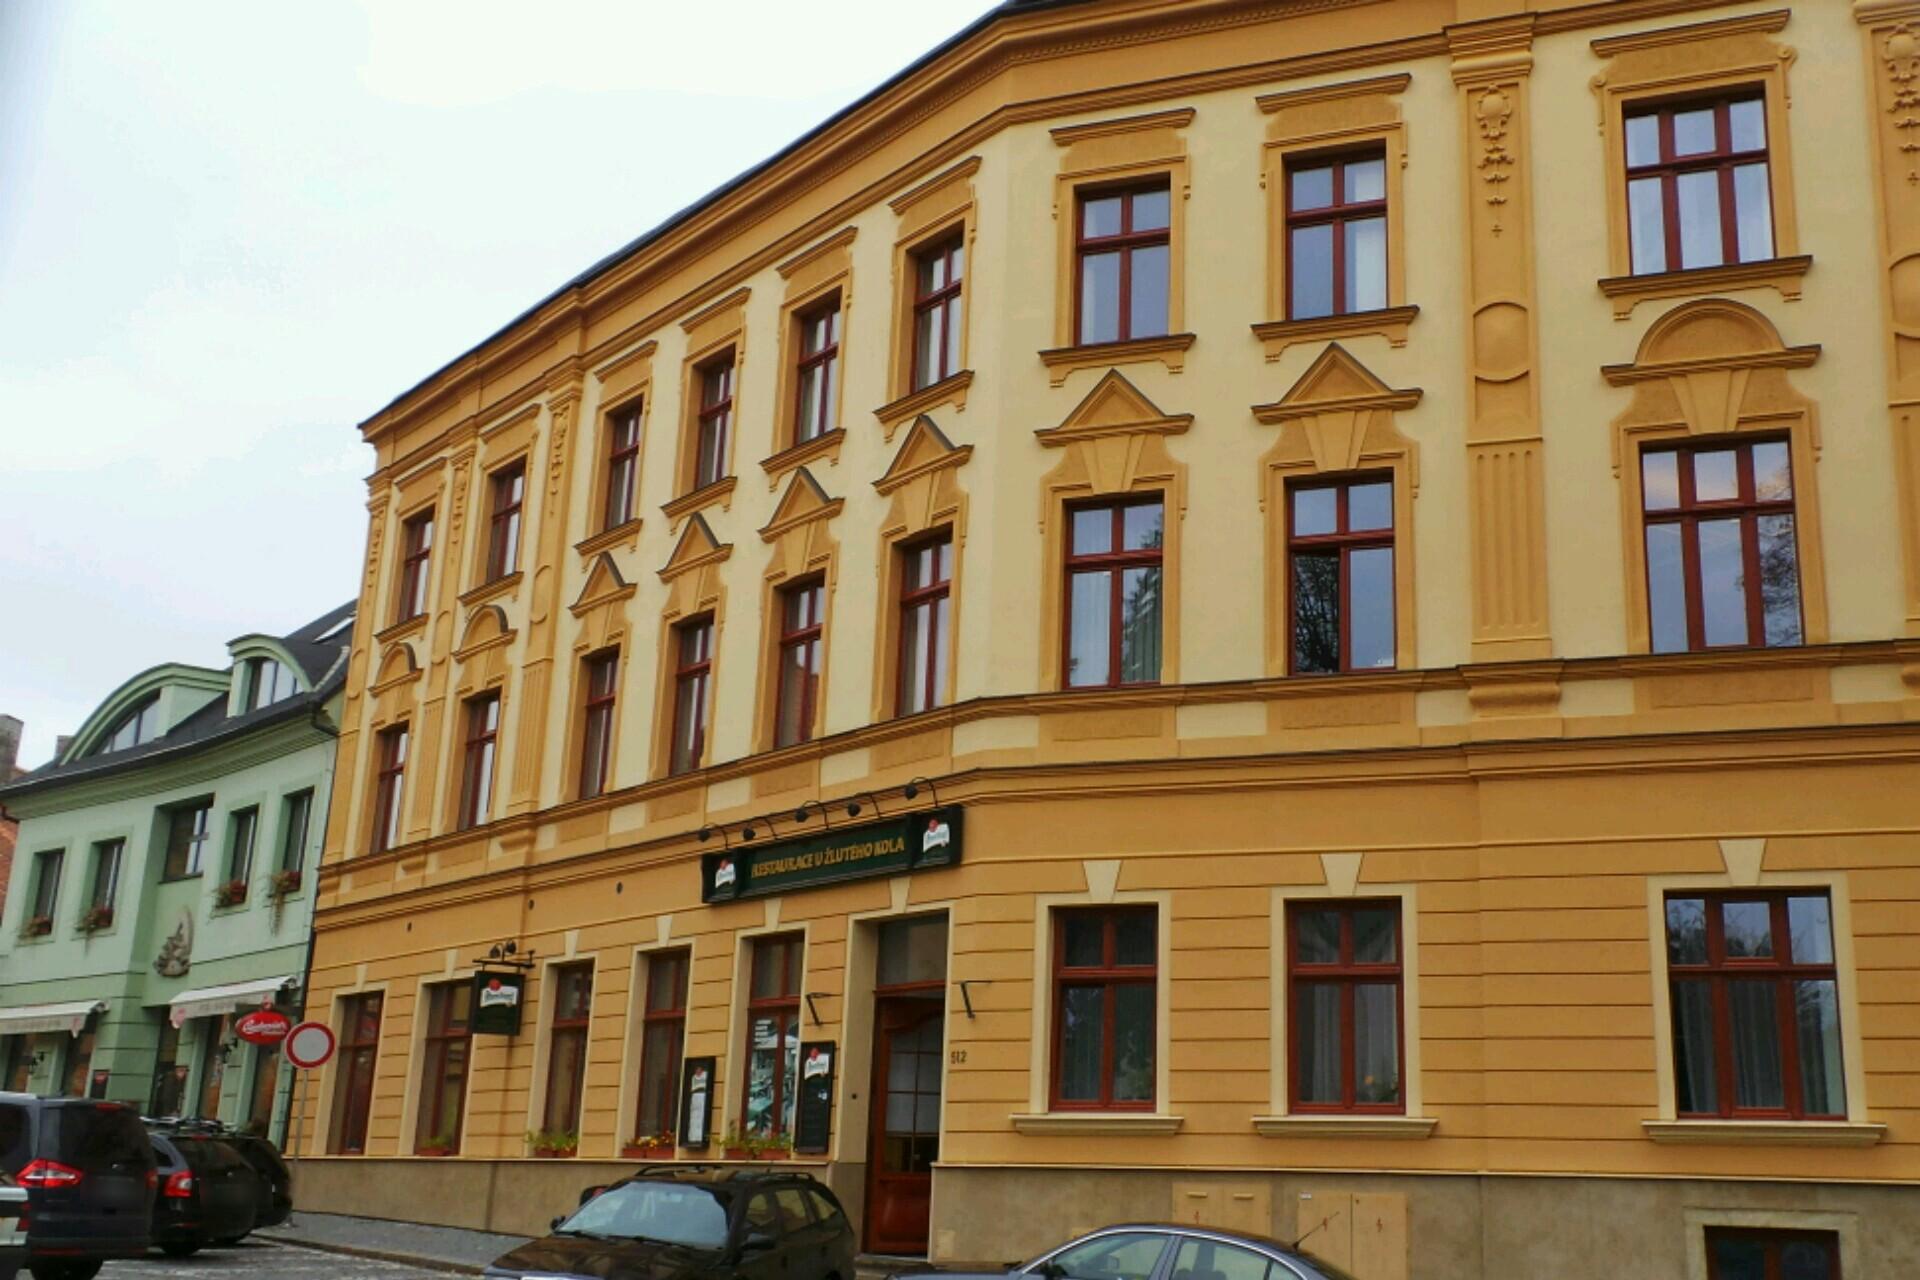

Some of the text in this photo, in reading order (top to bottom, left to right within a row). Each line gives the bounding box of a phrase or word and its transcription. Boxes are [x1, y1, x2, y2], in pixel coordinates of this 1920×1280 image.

[751, 853, 813, 878] RESTAURACE
[815, 852, 824, 866] U
[873, 836, 905, 856] KOLA
